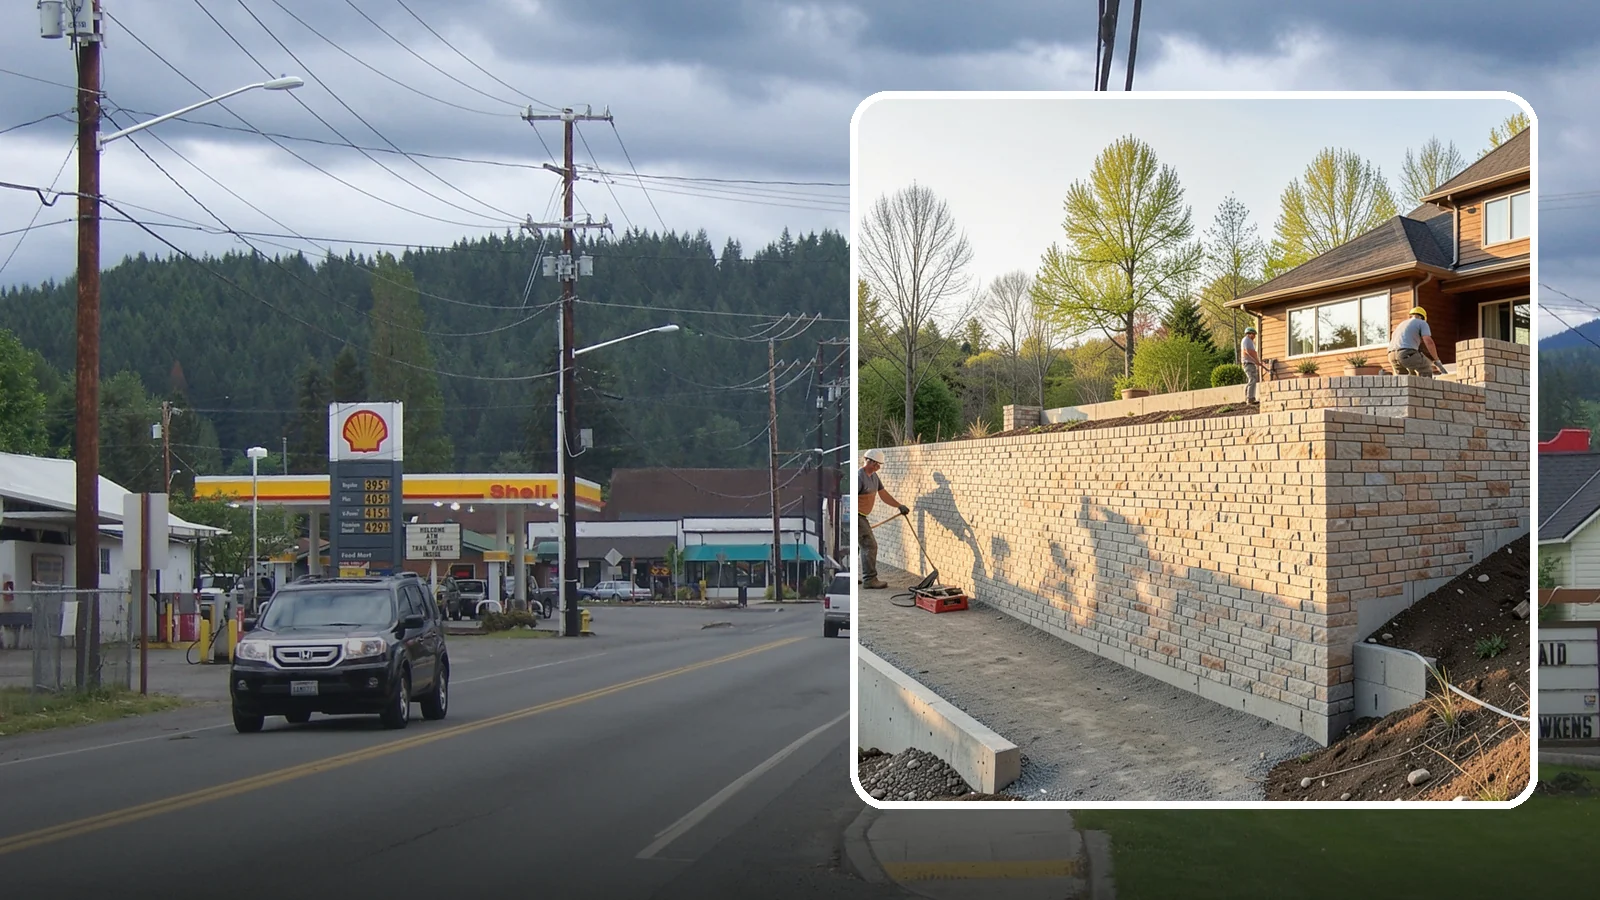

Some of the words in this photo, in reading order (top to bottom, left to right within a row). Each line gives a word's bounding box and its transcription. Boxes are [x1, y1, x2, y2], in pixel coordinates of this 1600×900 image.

[366, 480, 383, 490] 395
[490, 484, 547, 499] Shell
[366, 494, 383, 504] 405
[366, 508, 383, 518] 415
[366, 522, 383, 532] 429
